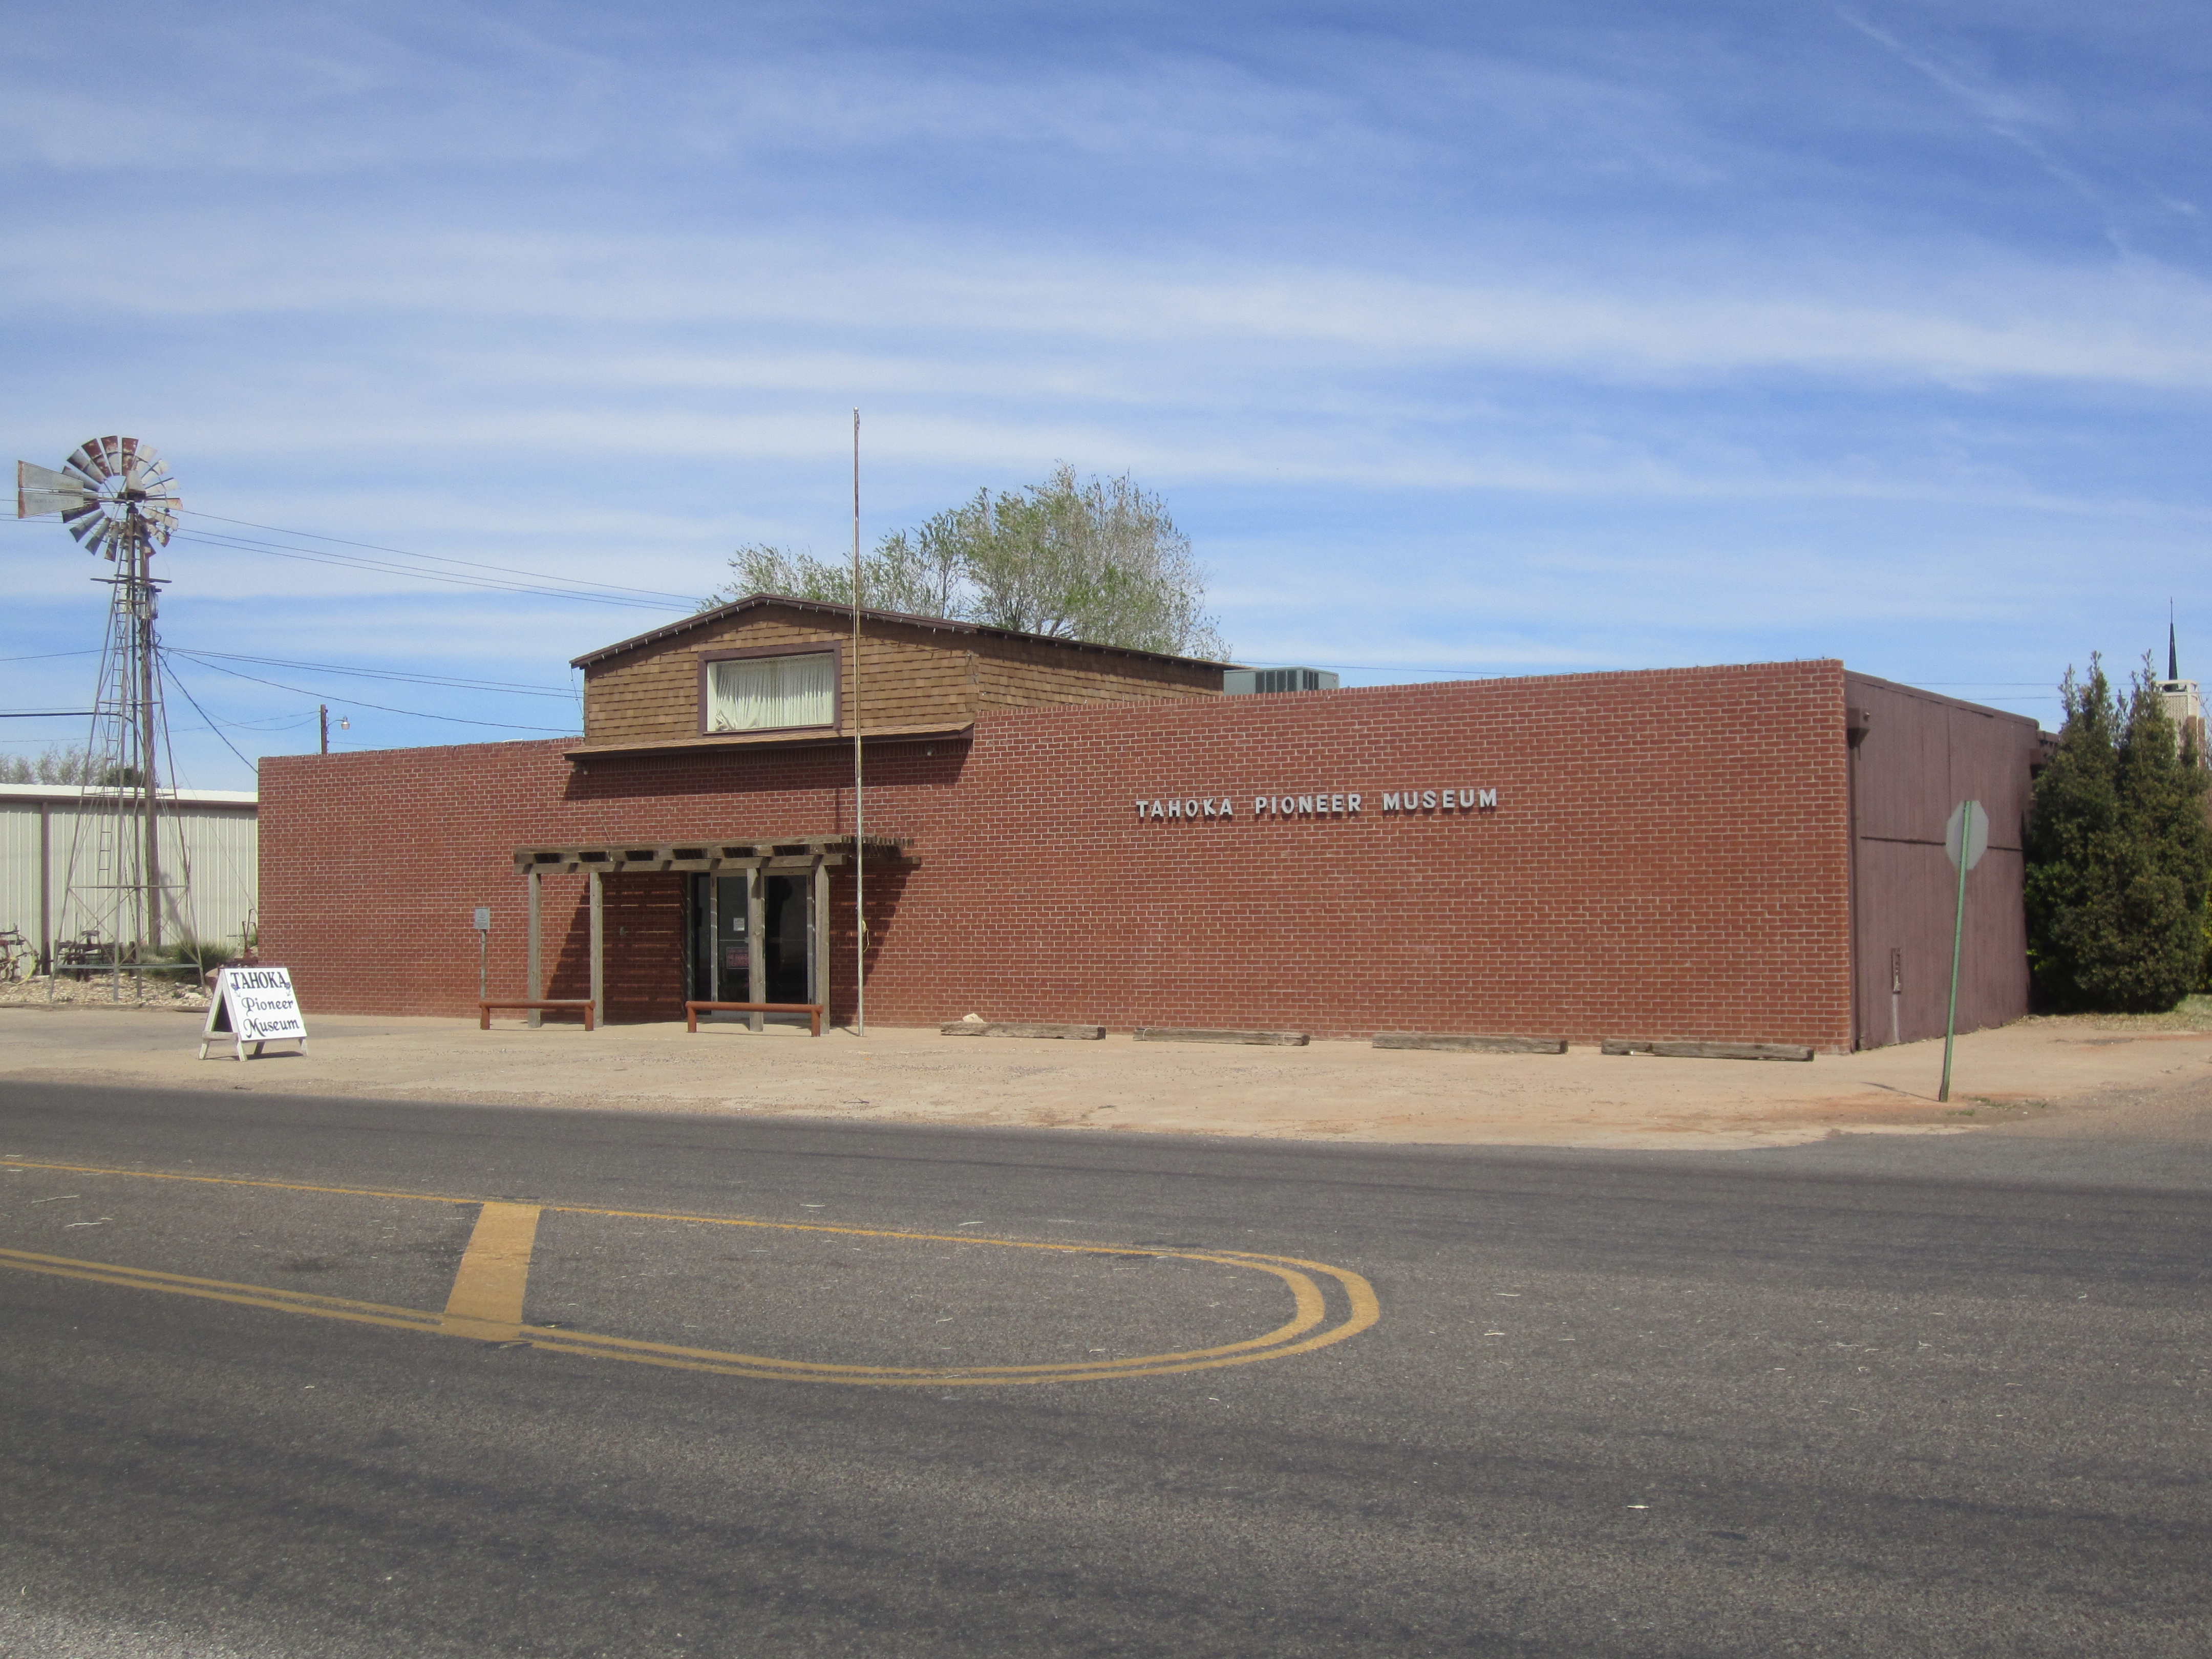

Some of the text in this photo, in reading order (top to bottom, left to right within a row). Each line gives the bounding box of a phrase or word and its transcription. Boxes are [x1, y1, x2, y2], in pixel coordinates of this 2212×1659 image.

[1135, 788, 1497, 818] TAHOKA PIONEER MUSEUM
[230, 971, 286, 989] TAHOKA
[241, 997, 293, 1017] Pioneer
[243, 1017, 300, 1038] Museum
